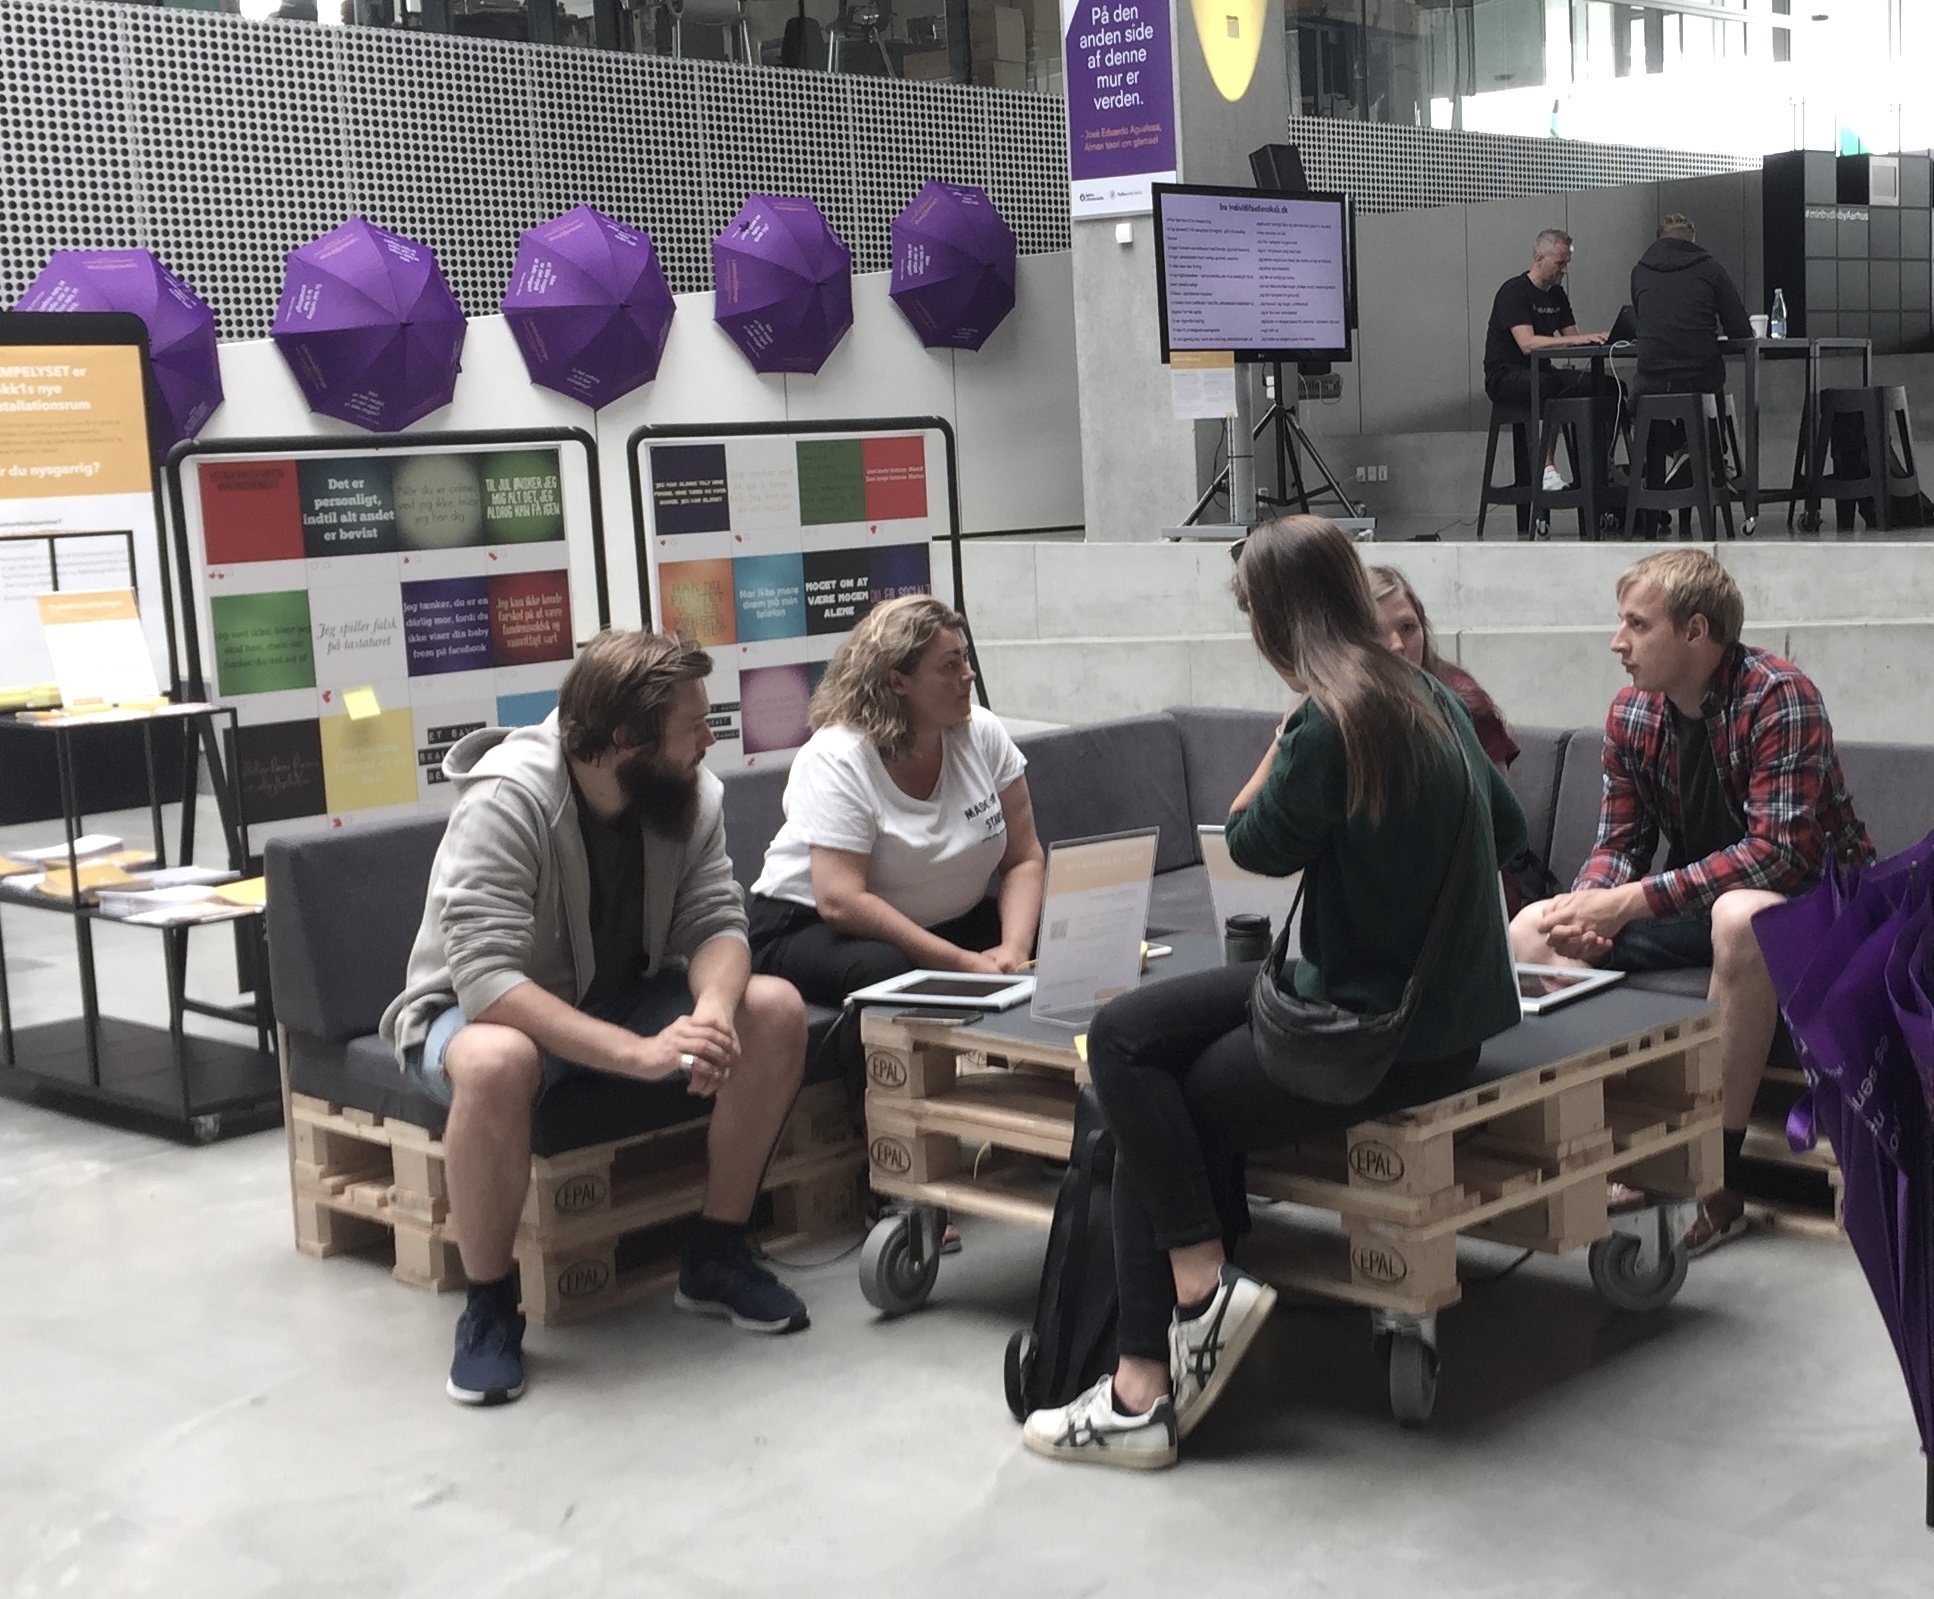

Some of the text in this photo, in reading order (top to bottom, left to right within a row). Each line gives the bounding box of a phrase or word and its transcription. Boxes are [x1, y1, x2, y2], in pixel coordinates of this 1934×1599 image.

[1092, 4, 1138, 25] På den
[1080, 24, 1153, 49] anden side
[1088, 47, 1146, 69] af denne
[1097, 70, 1140, 88] mur er
[1094, 90, 1144, 110] verden.
[72, 368, 87, 377] er
[37, 385, 62, 397] nye
[8, 464, 28, 477] du
[30, 462, 100, 478] nysgerrig?
[328, 478, 364, 490] Det er
[543, 476, 557, 488] JEG
[314, 494, 382, 510] personligt,
[303, 510, 394, 524] indtil alt andet
[324, 528, 378, 540] er bevist
[840, 578, 854, 588] OM
[857, 577, 868, 588] AT
[454, 598, 465, 607] du
[824, 606, 854, 618] ALENE
[468, 628, 489, 638] baby
[873, 1056, 901, 1081] EPAL
[878, 1143, 906, 1168] EPAL
[1357, 1150, 1396, 1176] EPAL
[1360, 1248, 1398, 1278] EPAL
